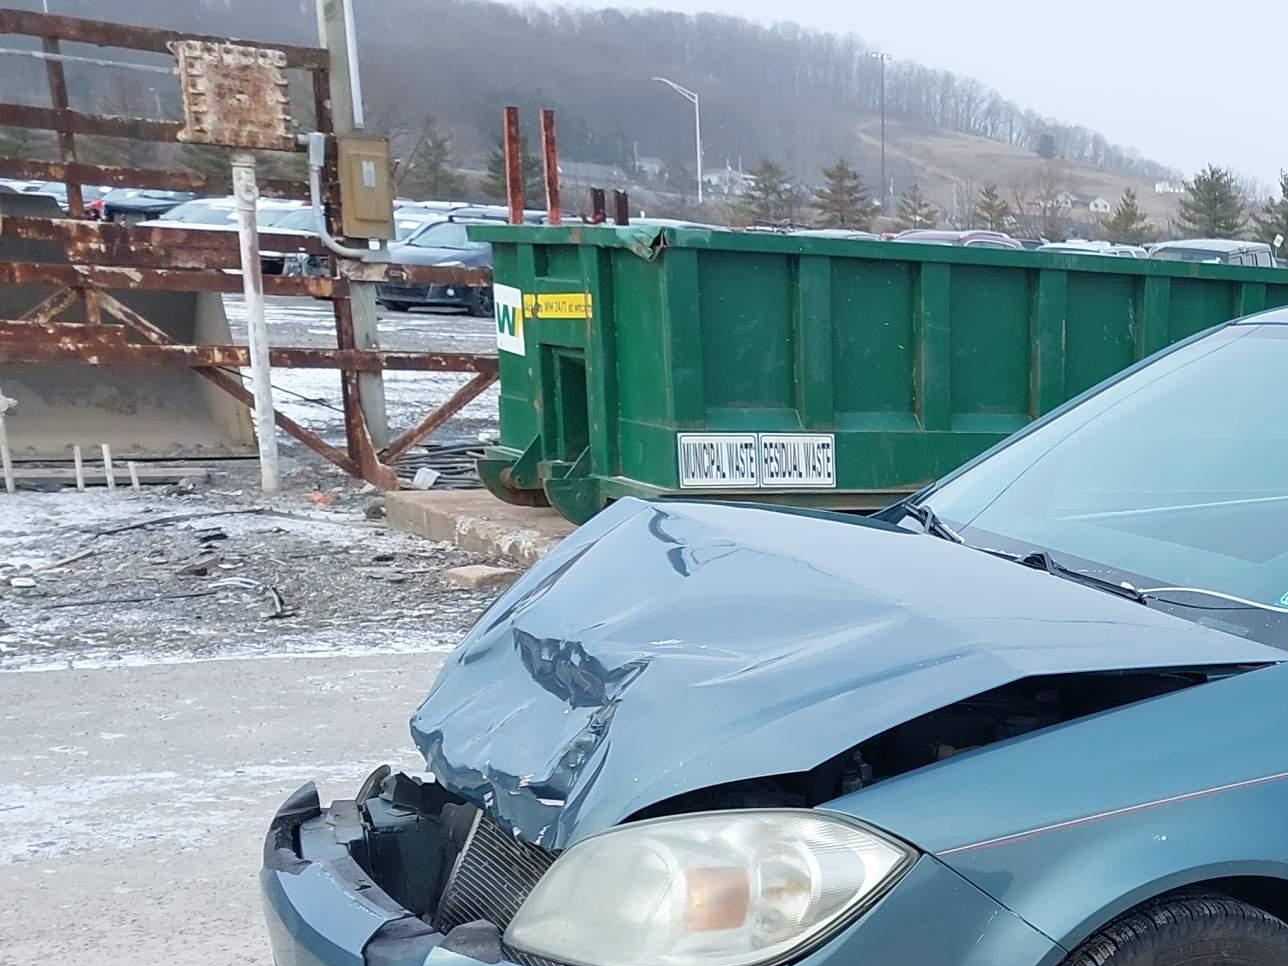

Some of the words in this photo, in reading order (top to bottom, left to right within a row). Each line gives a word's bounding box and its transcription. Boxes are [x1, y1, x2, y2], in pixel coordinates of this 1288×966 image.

[682, 442, 726, 479] MUNICIPAL
[727, 442, 755, 479] WASTE
[763, 442, 803, 479] RESIDUAL
[804, 442, 832, 479] WASTE
